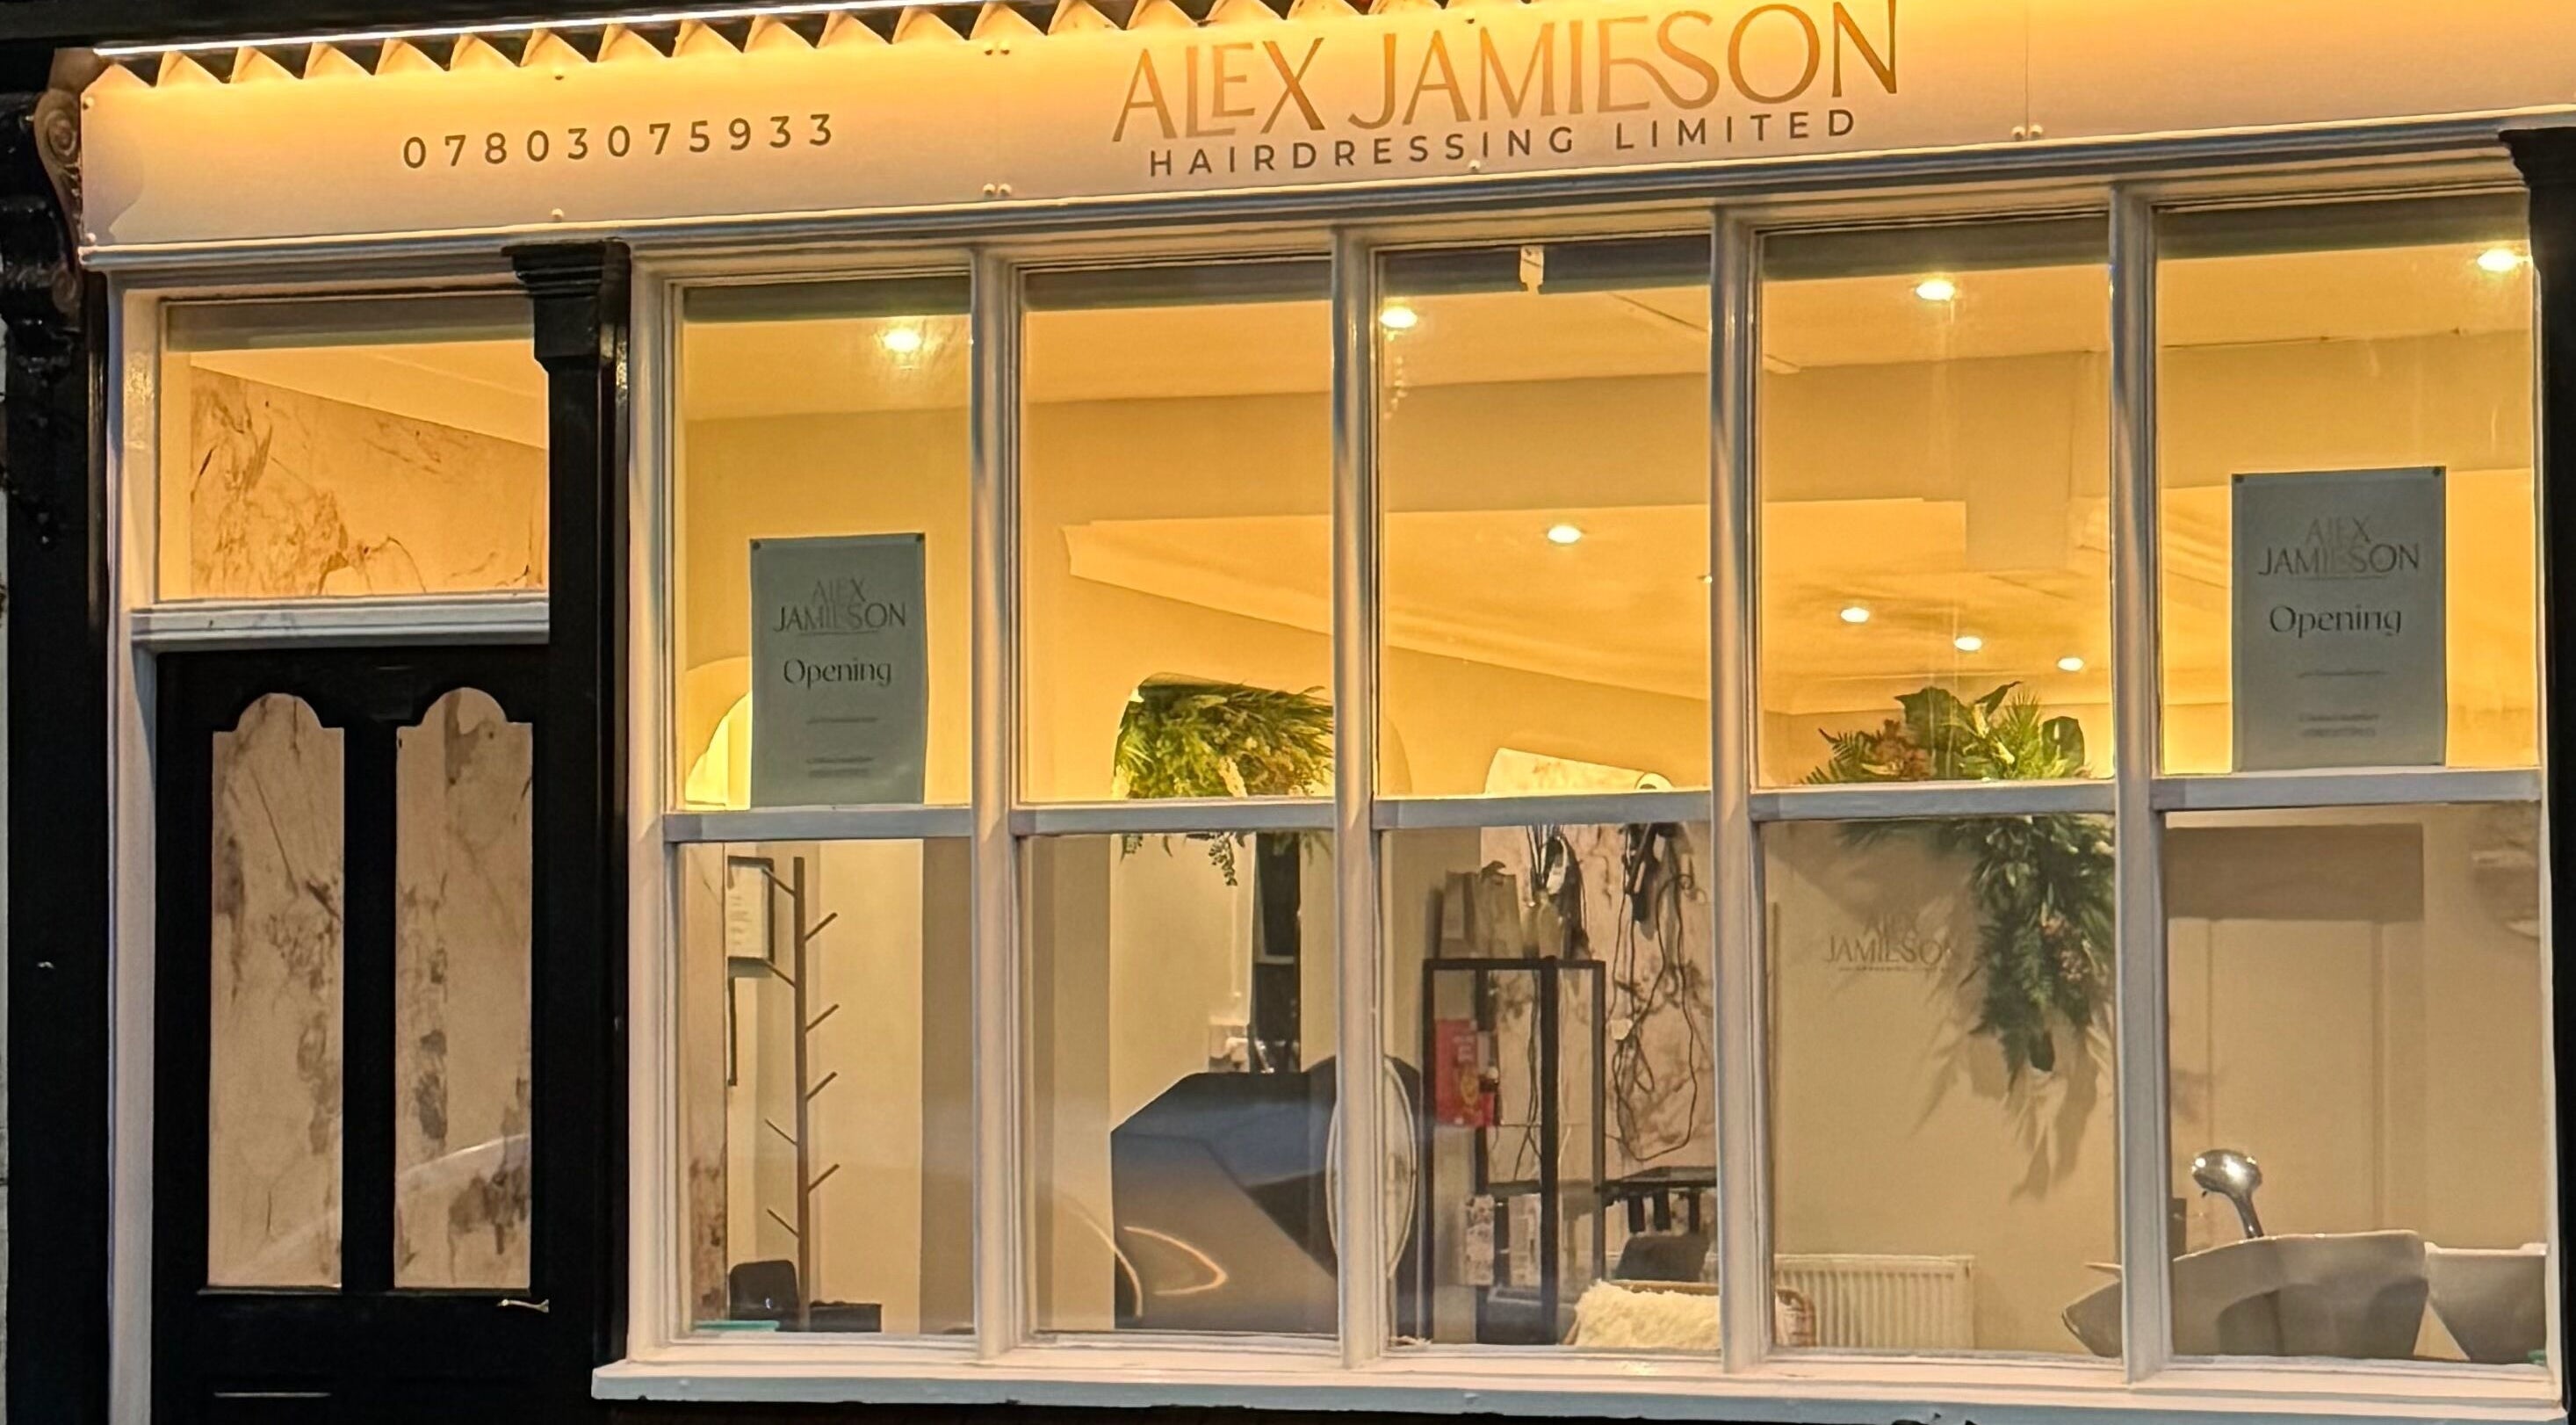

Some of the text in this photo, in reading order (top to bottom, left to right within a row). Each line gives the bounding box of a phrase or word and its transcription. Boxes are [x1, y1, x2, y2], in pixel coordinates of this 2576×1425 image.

[1112, 0, 1898, 143] ALEX JAMIESON
[402, 112, 834, 170] 07803075933
[1150, 108, 1857, 177] HAIRDRESSING LIMITED
[2269, 604, 2403, 639] Opening
[783, 657, 892, 691] Opening
